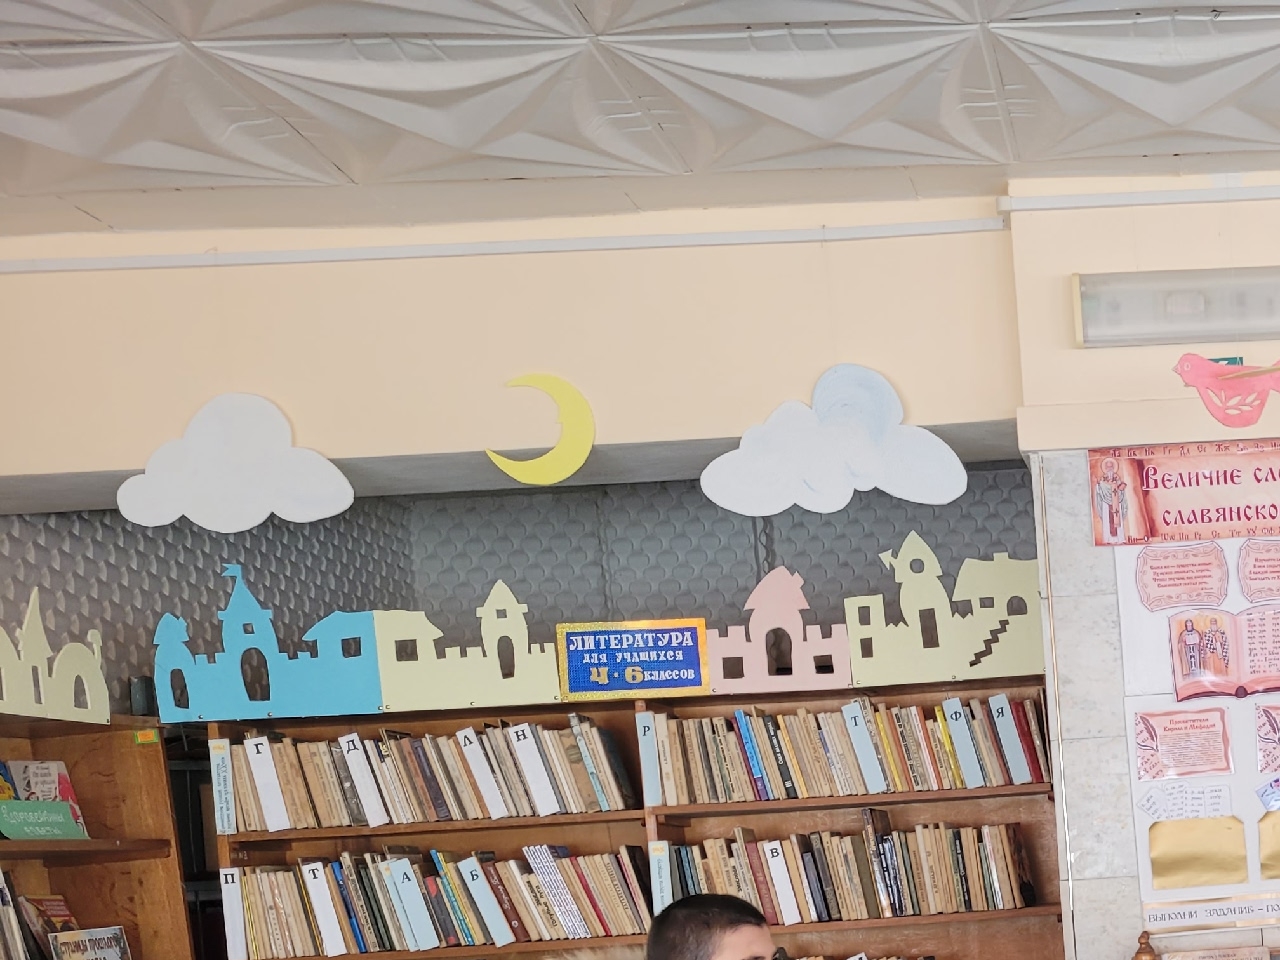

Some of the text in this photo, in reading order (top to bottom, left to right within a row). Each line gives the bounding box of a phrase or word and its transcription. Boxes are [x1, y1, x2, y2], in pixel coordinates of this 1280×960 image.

[1142, 464, 1242, 491] Величие
[569, 631, 694, 651] ЛИТЕРАТУРА
[950, 711, 961, 721] Ф
[997, 707, 1004, 718] Я
[851, 716, 858, 726] Т
[514, 730, 528, 742] Н
[643, 726, 650, 736] Р
[347, 739, 359, 754] Д
[464, 735, 473, 747] Л
[254, 743, 263, 754] Г
[770, 848, 779, 858] В
[223, 874, 235, 884] П
[309, 868, 319, 879] Т
[402, 872, 412, 883] А
[470, 870, 479, 881] Б
